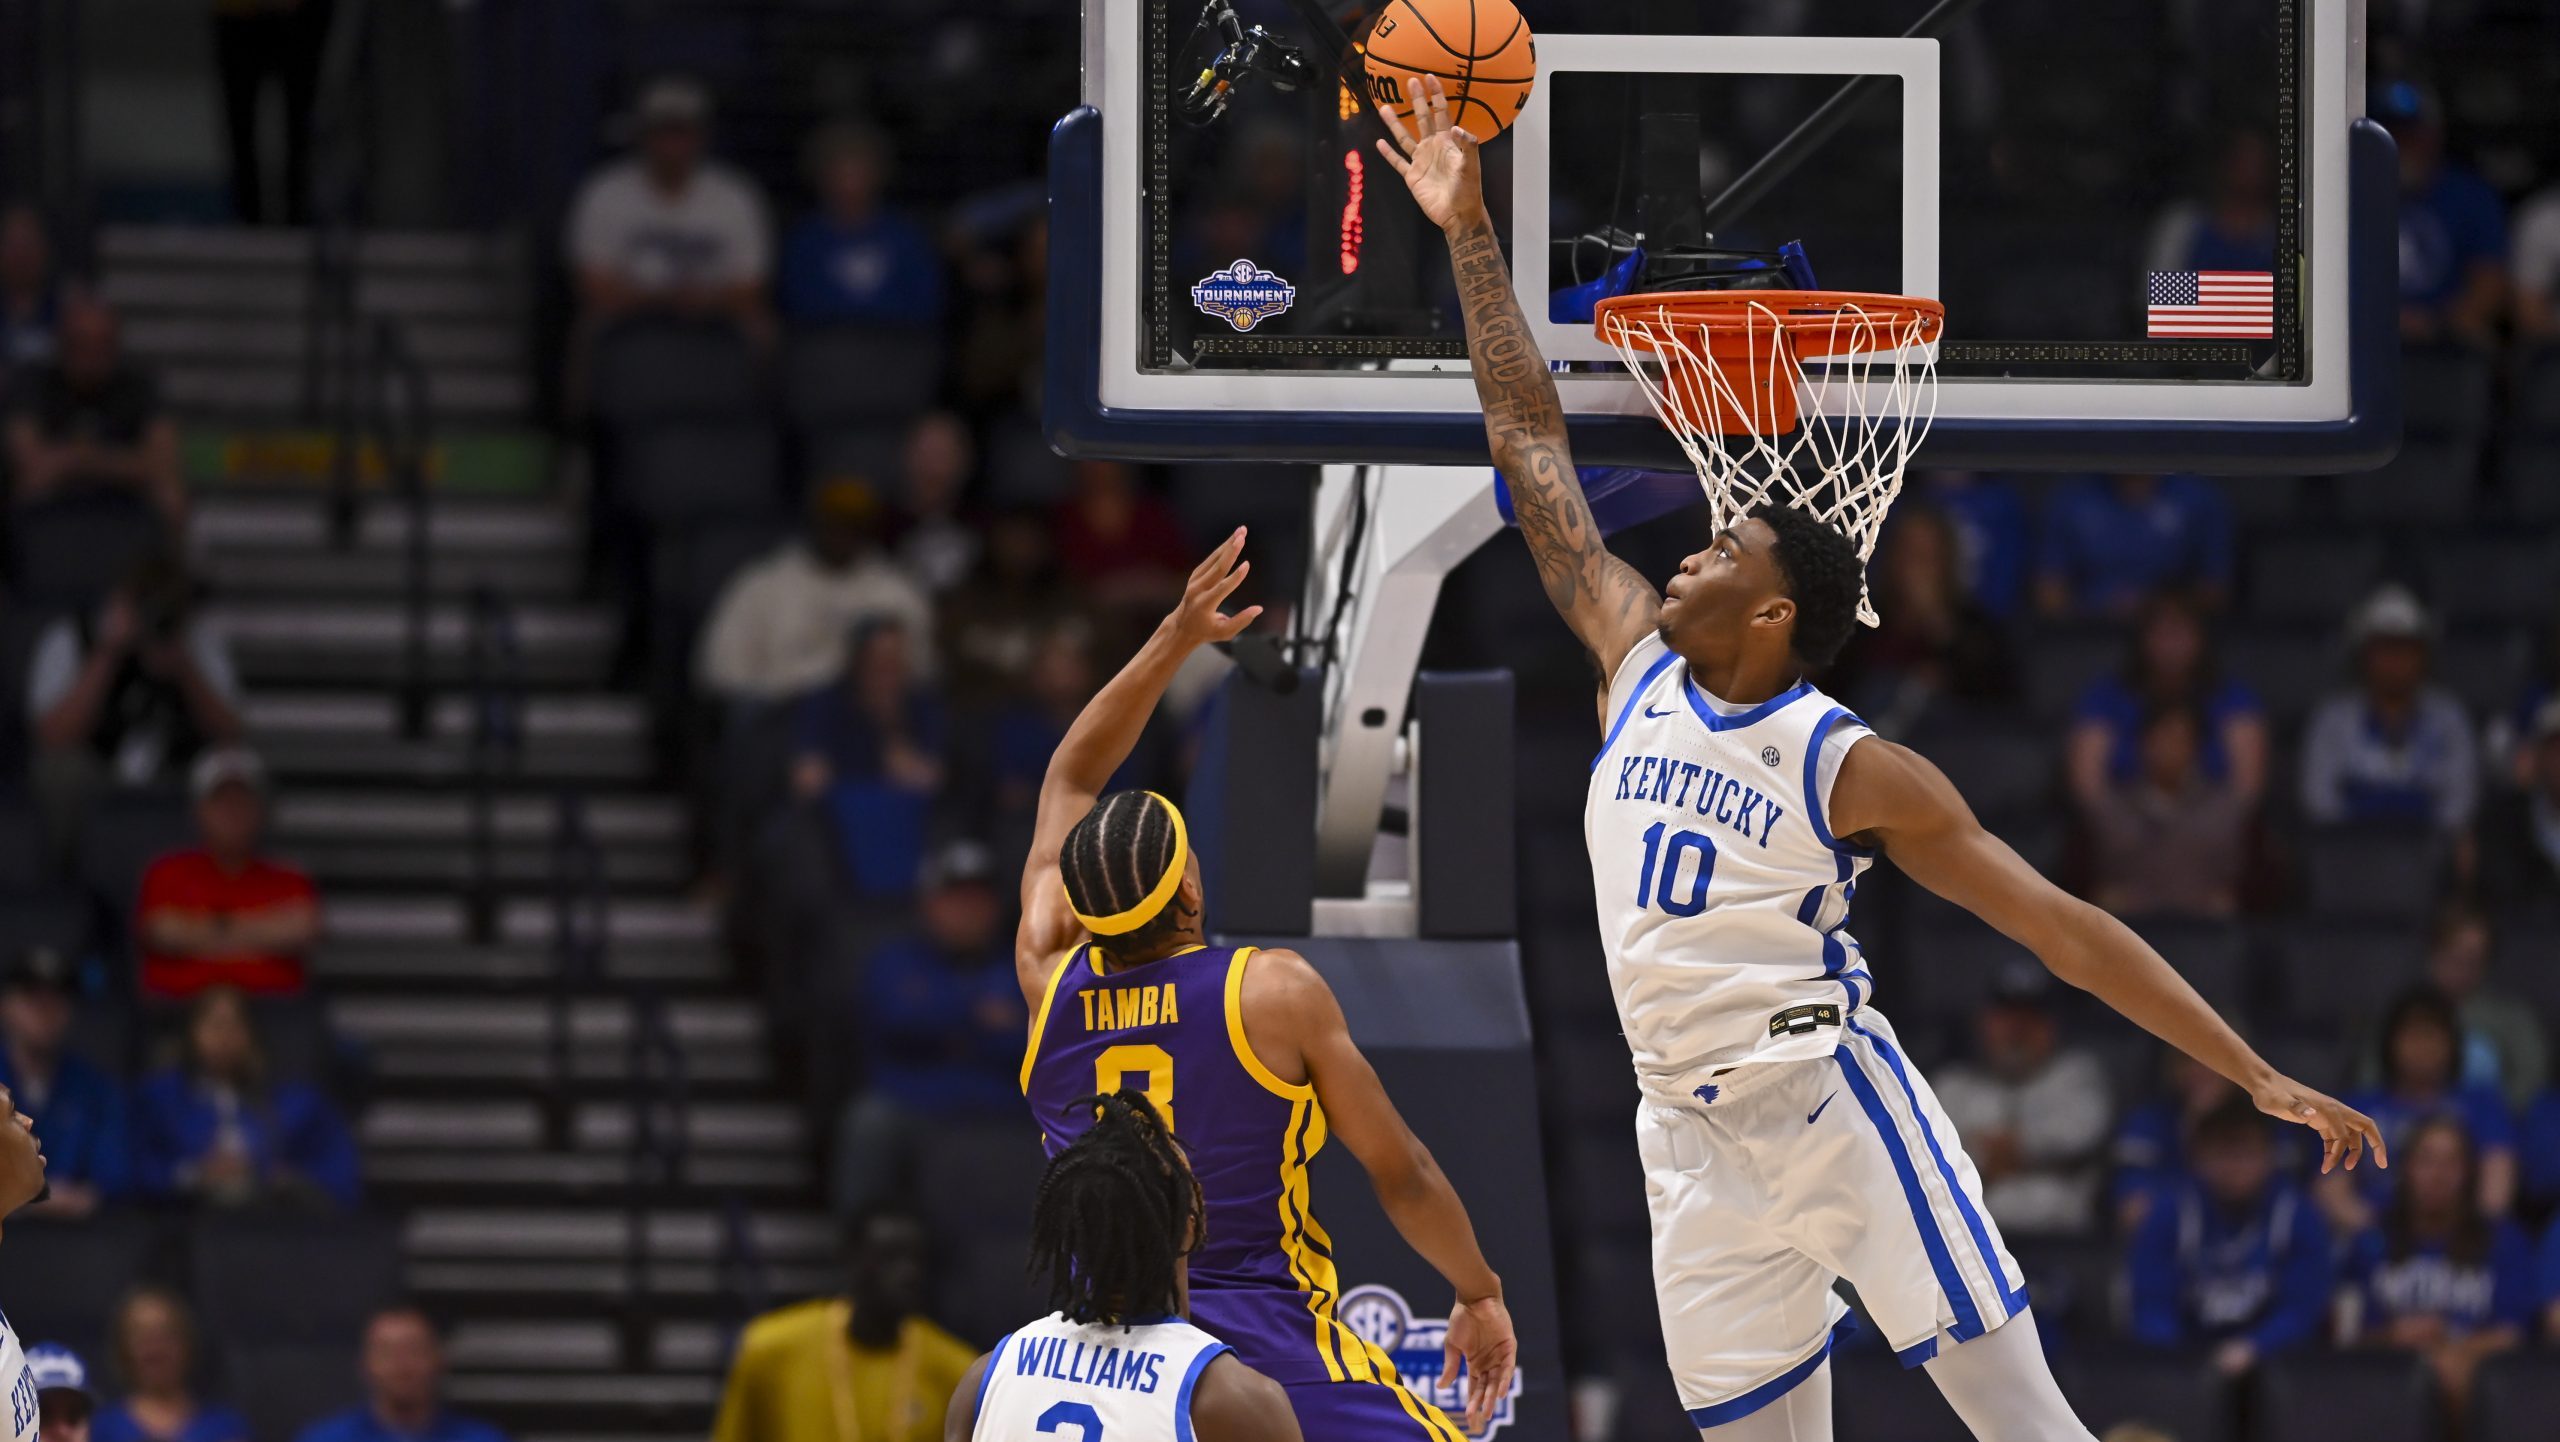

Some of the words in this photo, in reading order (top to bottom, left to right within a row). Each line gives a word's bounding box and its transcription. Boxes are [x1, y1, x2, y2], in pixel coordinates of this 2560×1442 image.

[1195, 289, 1292, 304] TOURNAMENT
[1234, 264, 1253, 283] SEC
[1472, 315, 1532, 383] GOD
[1762, 748, 1780, 765] SEC
[1615, 756, 1783, 849] KENTUCKY
[1636, 821, 1717, 917] 10
[1079, 983, 1179, 1031] TAMBA
[1817, 1009, 1831, 1019] 48
[1346, 1302, 1398, 1349] SEC
[1016, 1336, 1165, 1394] WILLIAMS
